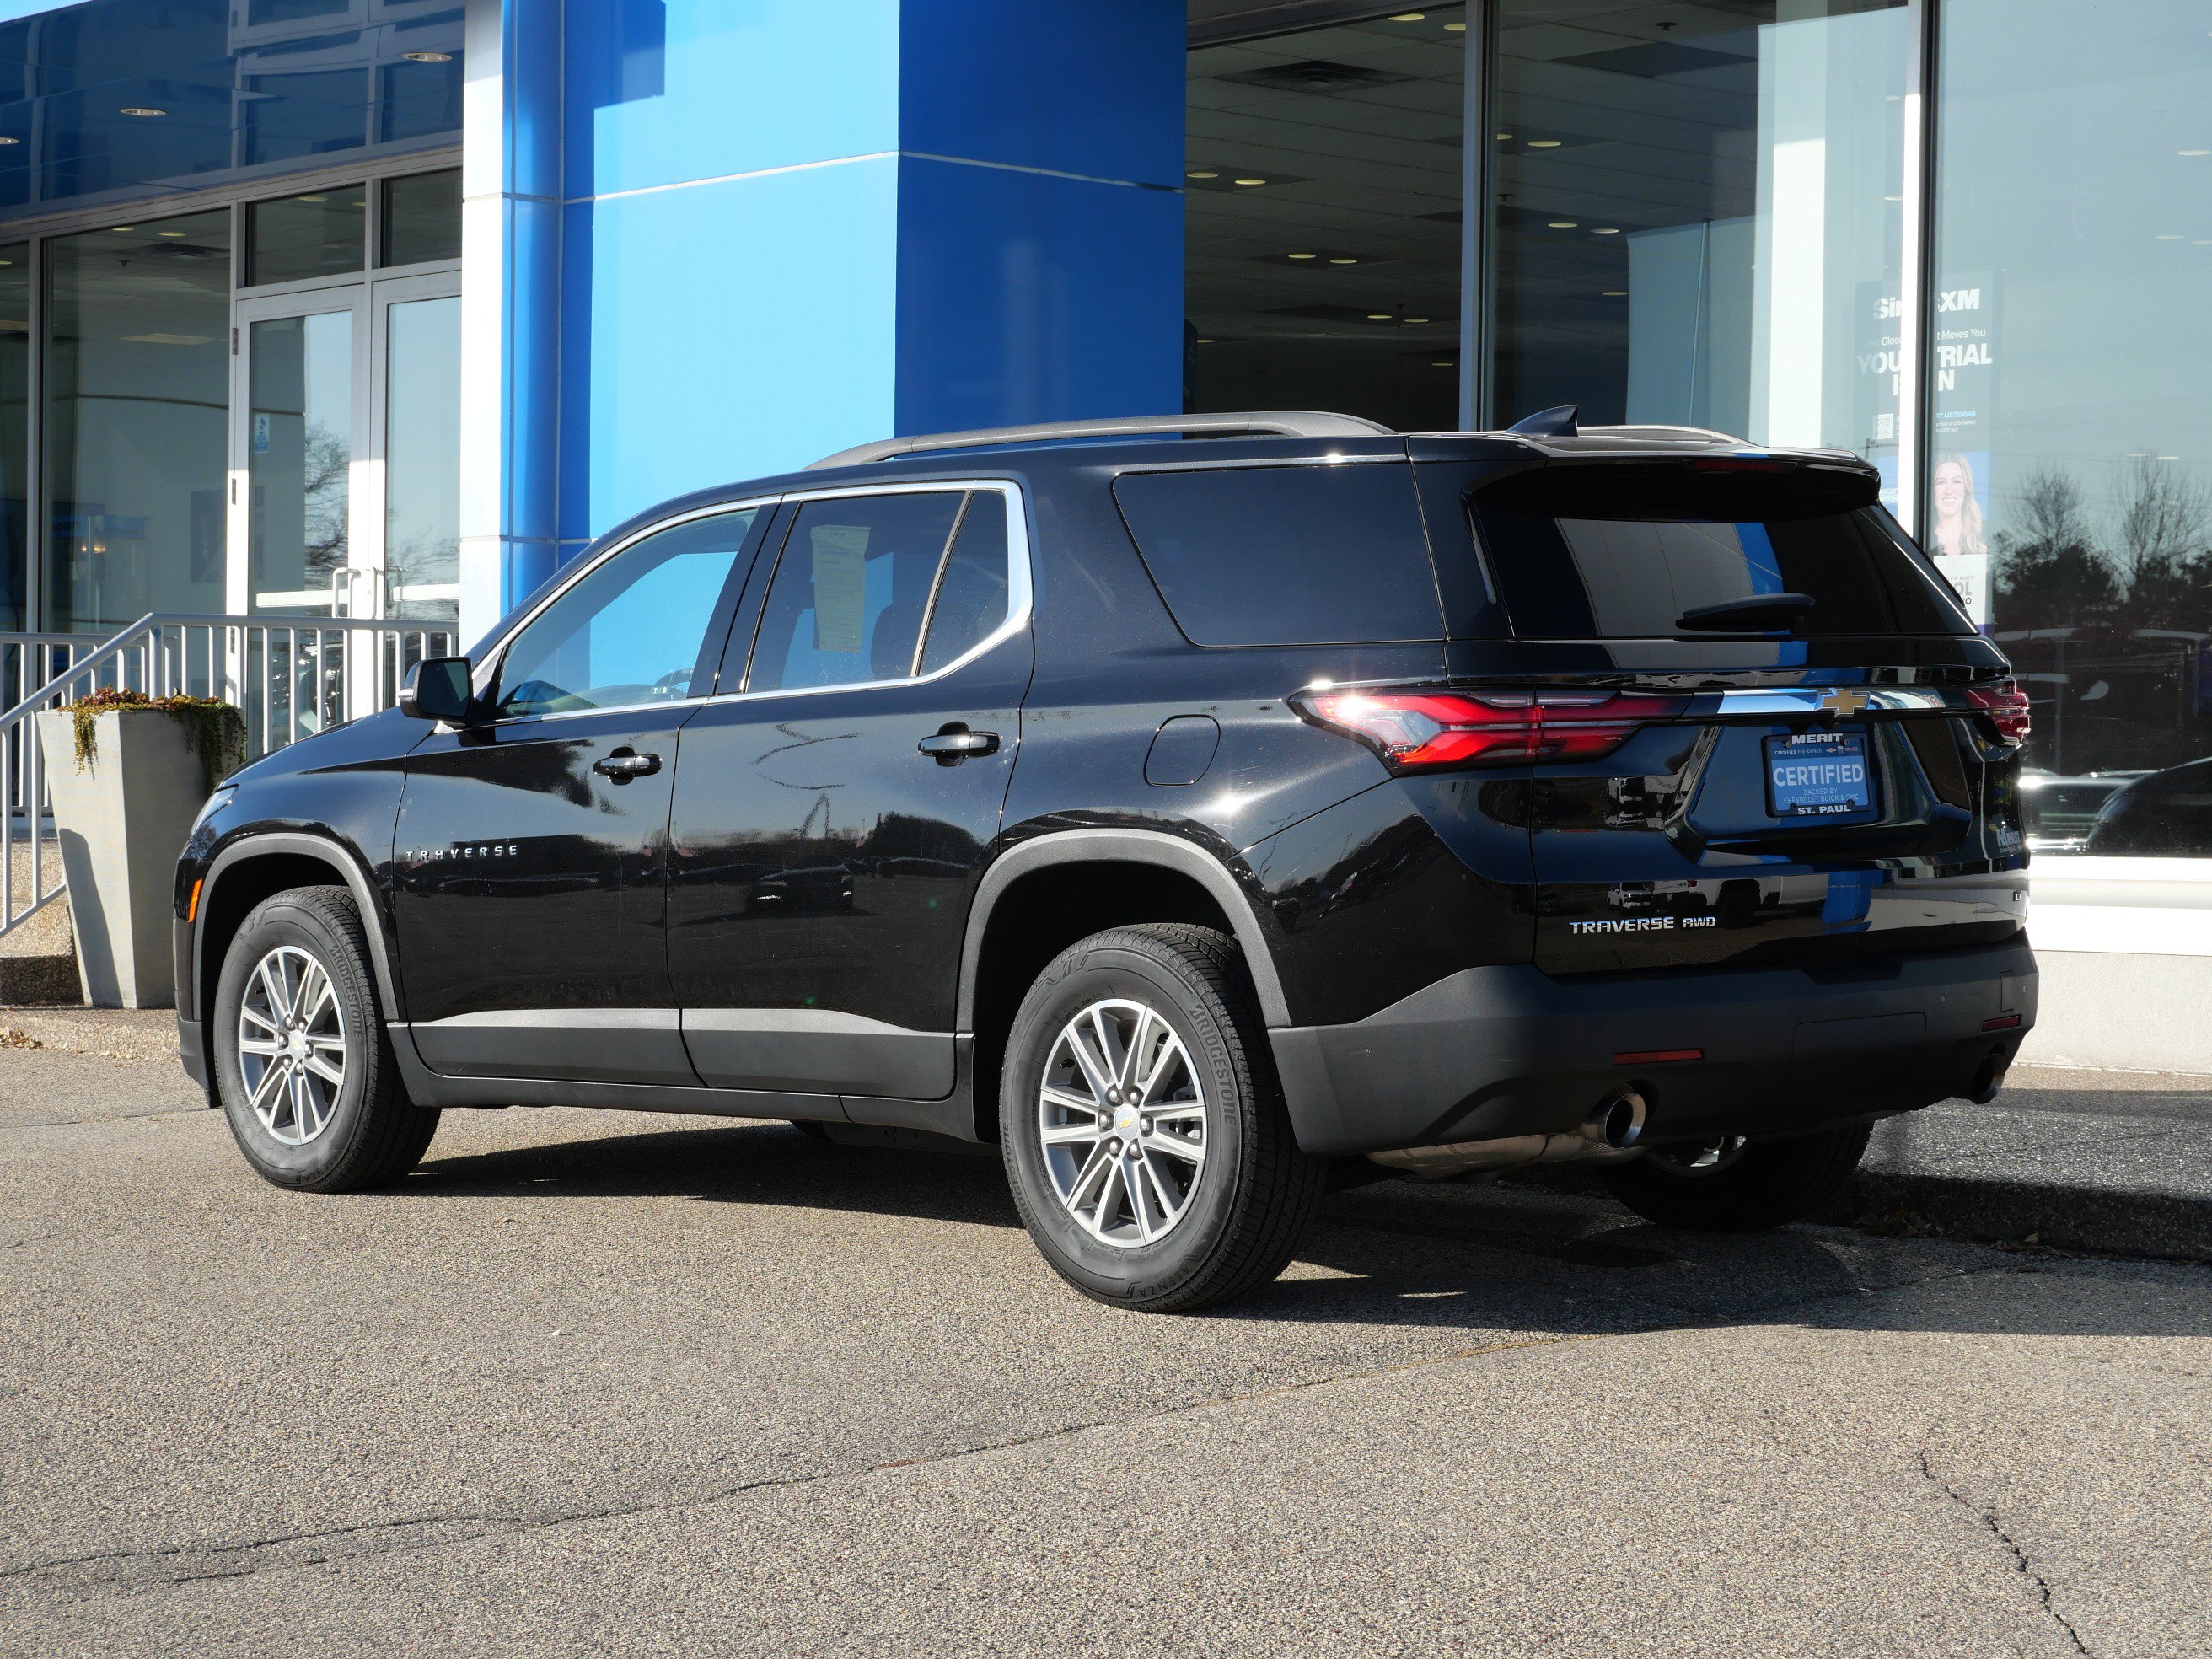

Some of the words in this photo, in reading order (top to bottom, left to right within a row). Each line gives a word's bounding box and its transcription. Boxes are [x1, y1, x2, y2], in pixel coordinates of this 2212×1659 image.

[1941, 330, 1968, 340] Moves
[1970, 328, 1986, 337] You
[1856, 350, 1902, 375] YOU
[1791, 733, 1843, 744] MERIT
[1773, 763, 1864, 787] CERTIFIED
[1783, 795, 1818, 804] CHEVROLET
[1821, 794, 1839, 803] BUICK
[1804, 787, 1828, 796] BACKED
[1797, 807, 1816, 815] ST.
[1819, 804, 1851, 813] PAUL
[405, 845, 518, 862] TRAVERSE
[1569, 916, 1674, 934] TRAVERSE
[1683, 916, 1716, 928] AWD
[329, 944, 362, 1038] BRIDGESTONE
[1189, 1004, 1237, 1125] BRIDGESTONE
